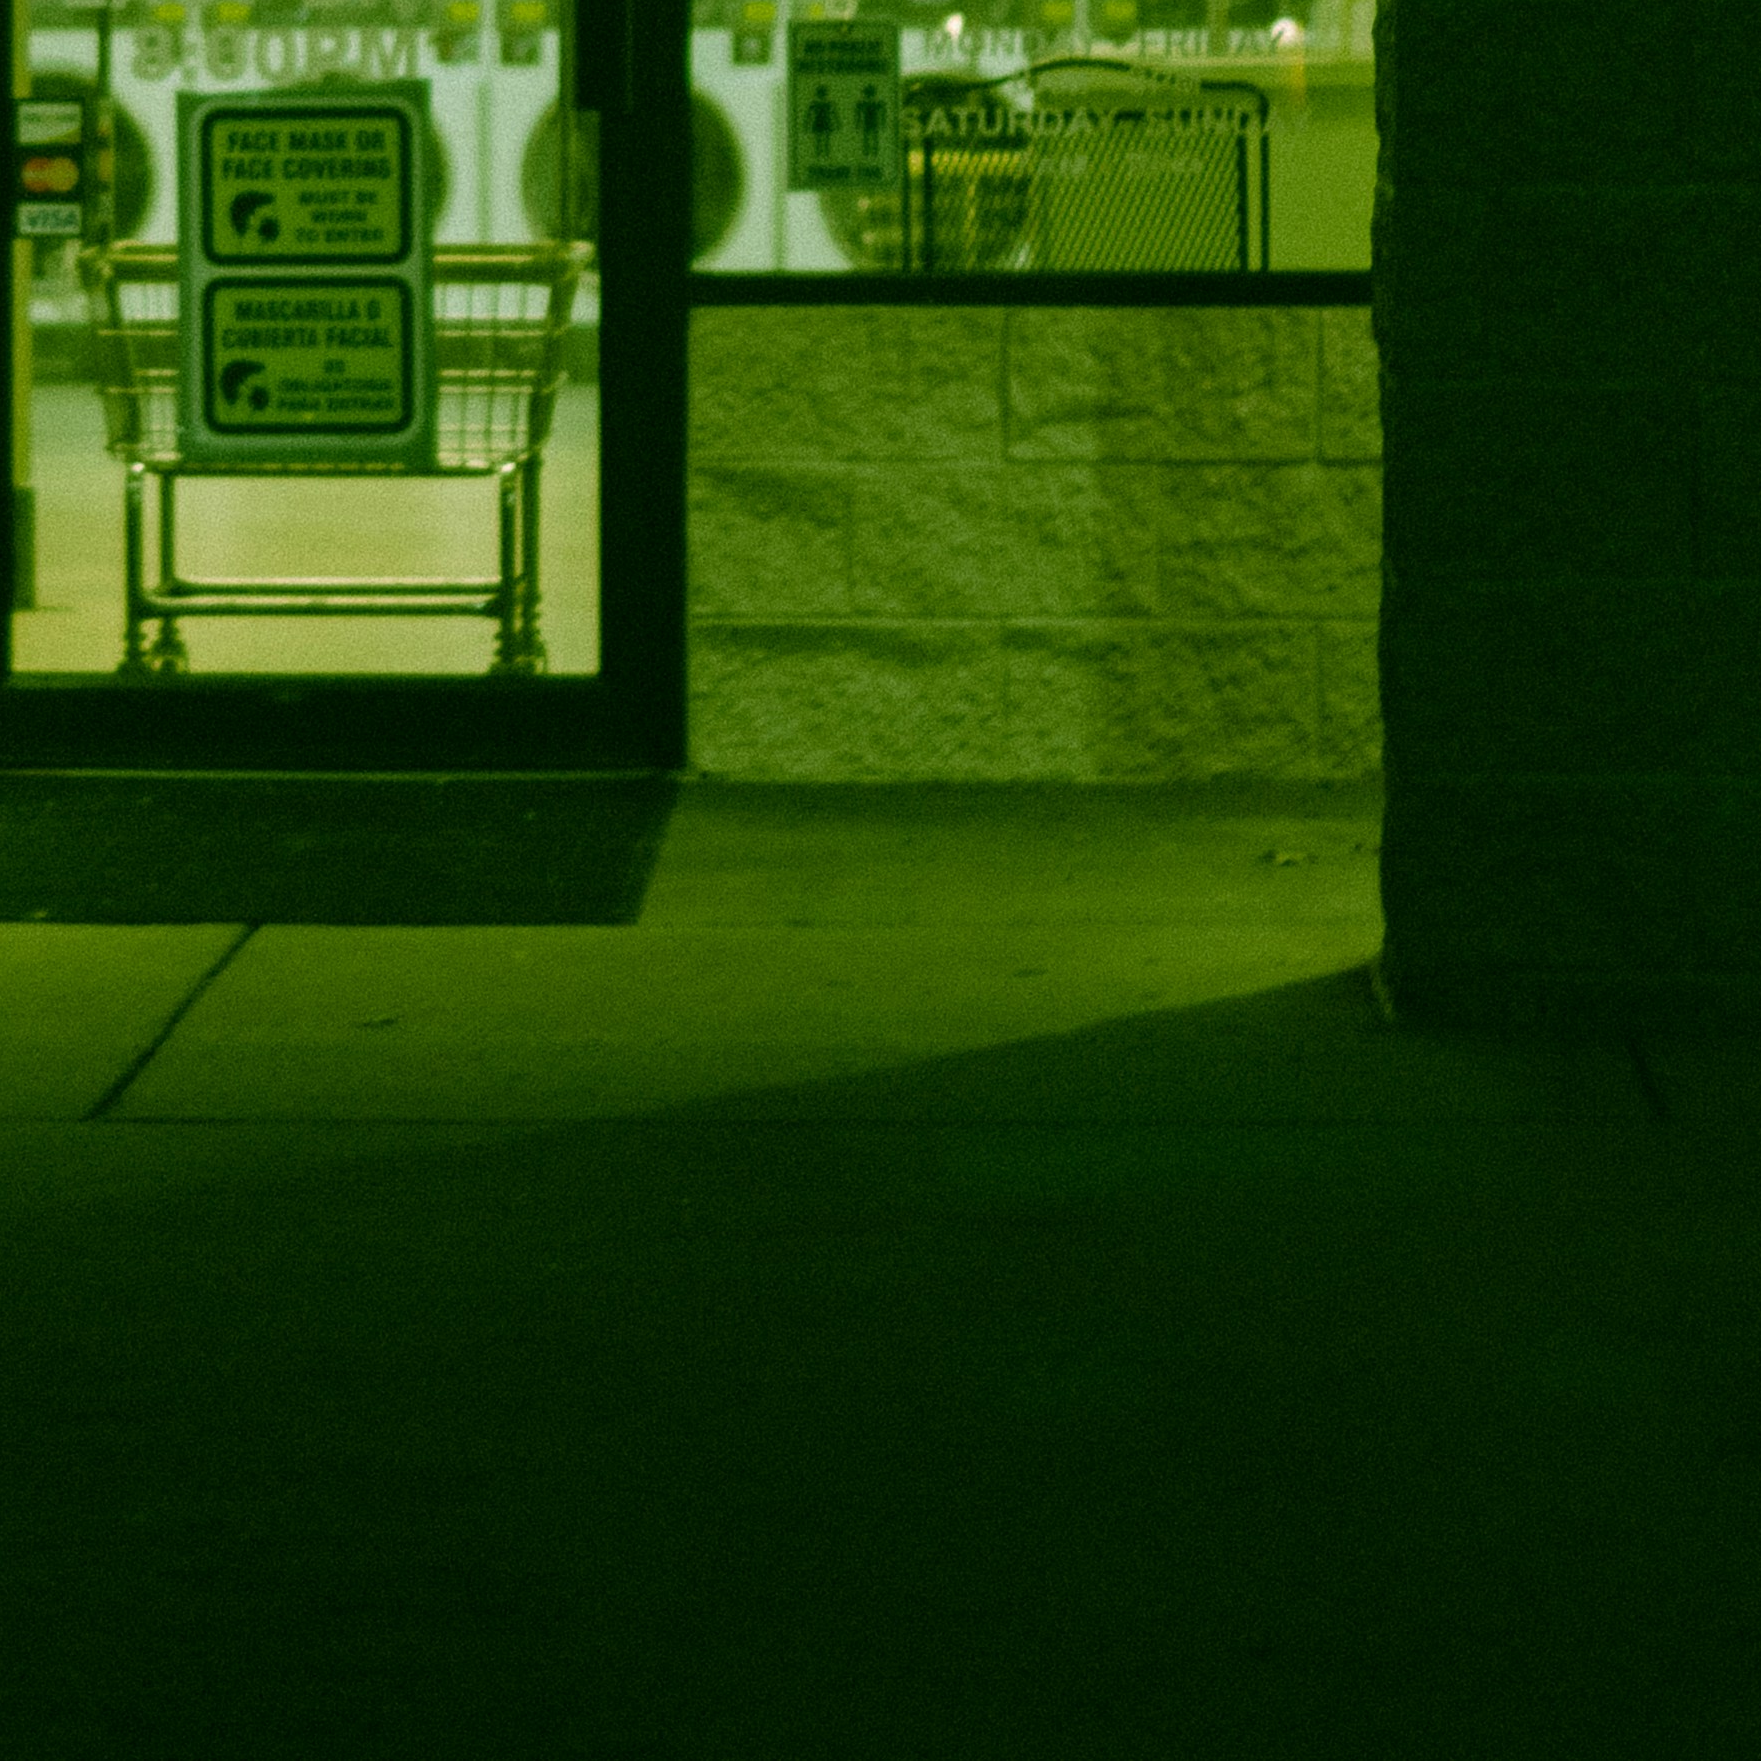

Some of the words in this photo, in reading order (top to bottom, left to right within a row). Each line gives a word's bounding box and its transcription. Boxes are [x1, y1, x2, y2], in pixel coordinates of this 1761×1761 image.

[899, 105, 1115, 137] SATURDAY
[227, 129, 279, 152] FACE
[289, 129, 347, 152] MASK
[355, 129, 386, 151] OR
[222, 158, 273, 180] FACE
[283, 157, 391, 180] COVERING
